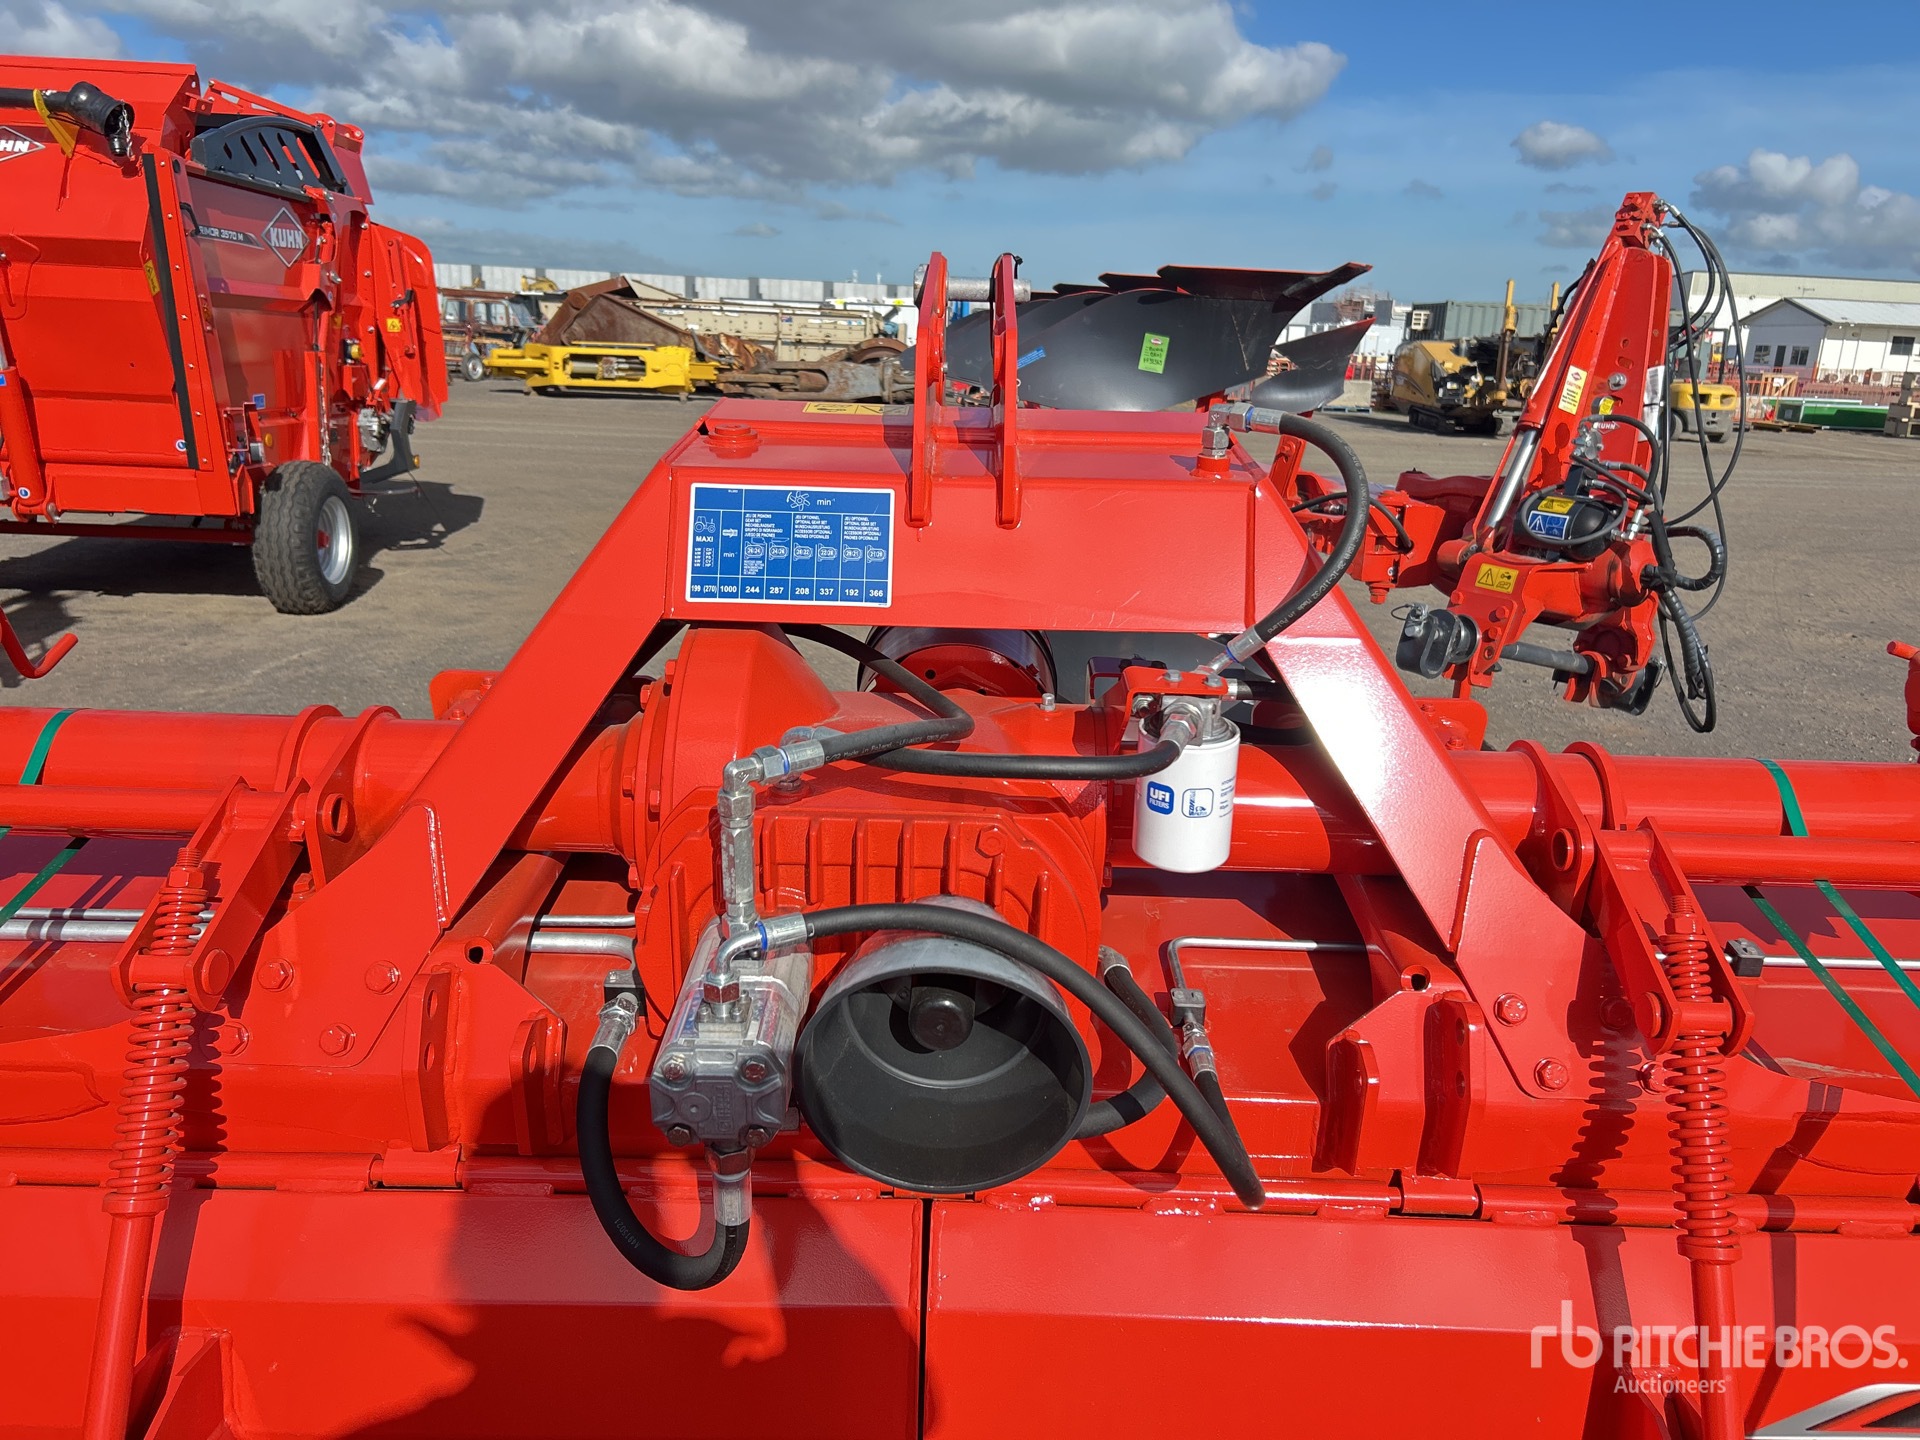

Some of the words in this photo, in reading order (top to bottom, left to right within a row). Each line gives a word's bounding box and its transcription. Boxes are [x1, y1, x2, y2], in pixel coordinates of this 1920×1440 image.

[198, 226, 220, 238] RIMOR
[220, 229, 237, 240] 3570
[269, 227, 304, 249] KUHN
[703, 585, 717, 593] (270)
[819, 588, 834, 596] 337
[1297, 598, 1312, 611] Made
[1267, 617, 1289, 634] Poland
[1149, 787, 1170, 803] UFI
[1149, 798, 1170, 809] FILTERS
